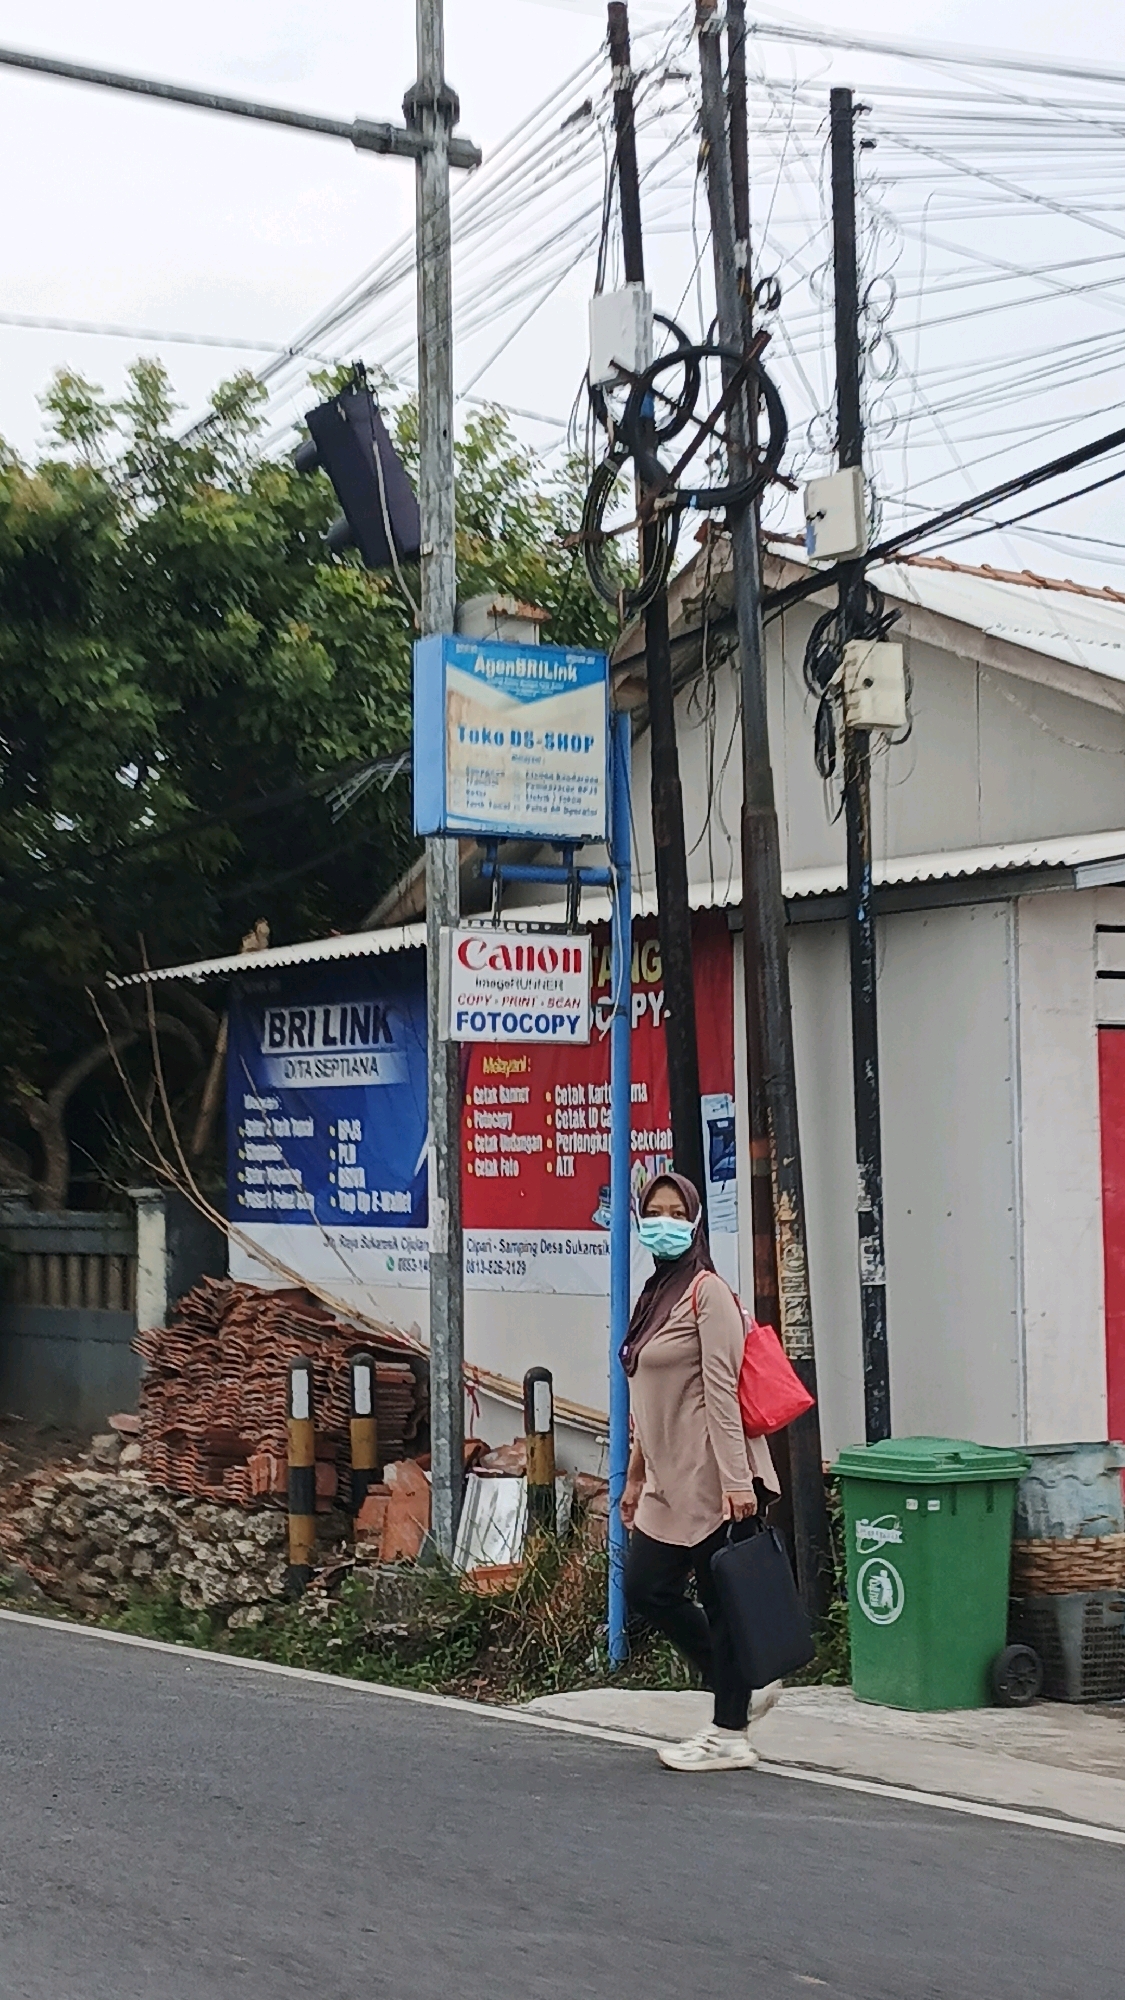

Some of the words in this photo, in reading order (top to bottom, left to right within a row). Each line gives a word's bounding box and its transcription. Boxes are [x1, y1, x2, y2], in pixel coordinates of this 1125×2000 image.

[458, 725, 505, 747] Toko
[457, 936, 582, 974] Canon
[457, 992, 493, 1007] COPY
[501, 995, 537, 1008] PRINT
[456, 1010, 581, 1036] FOTOCOPY
[555, 1084, 586, 1106] Cetak
[555, 1108, 586, 1129] Cetak
[588, 1107, 599, 1128] ID
[540, 1239, 564, 1255] Desa
